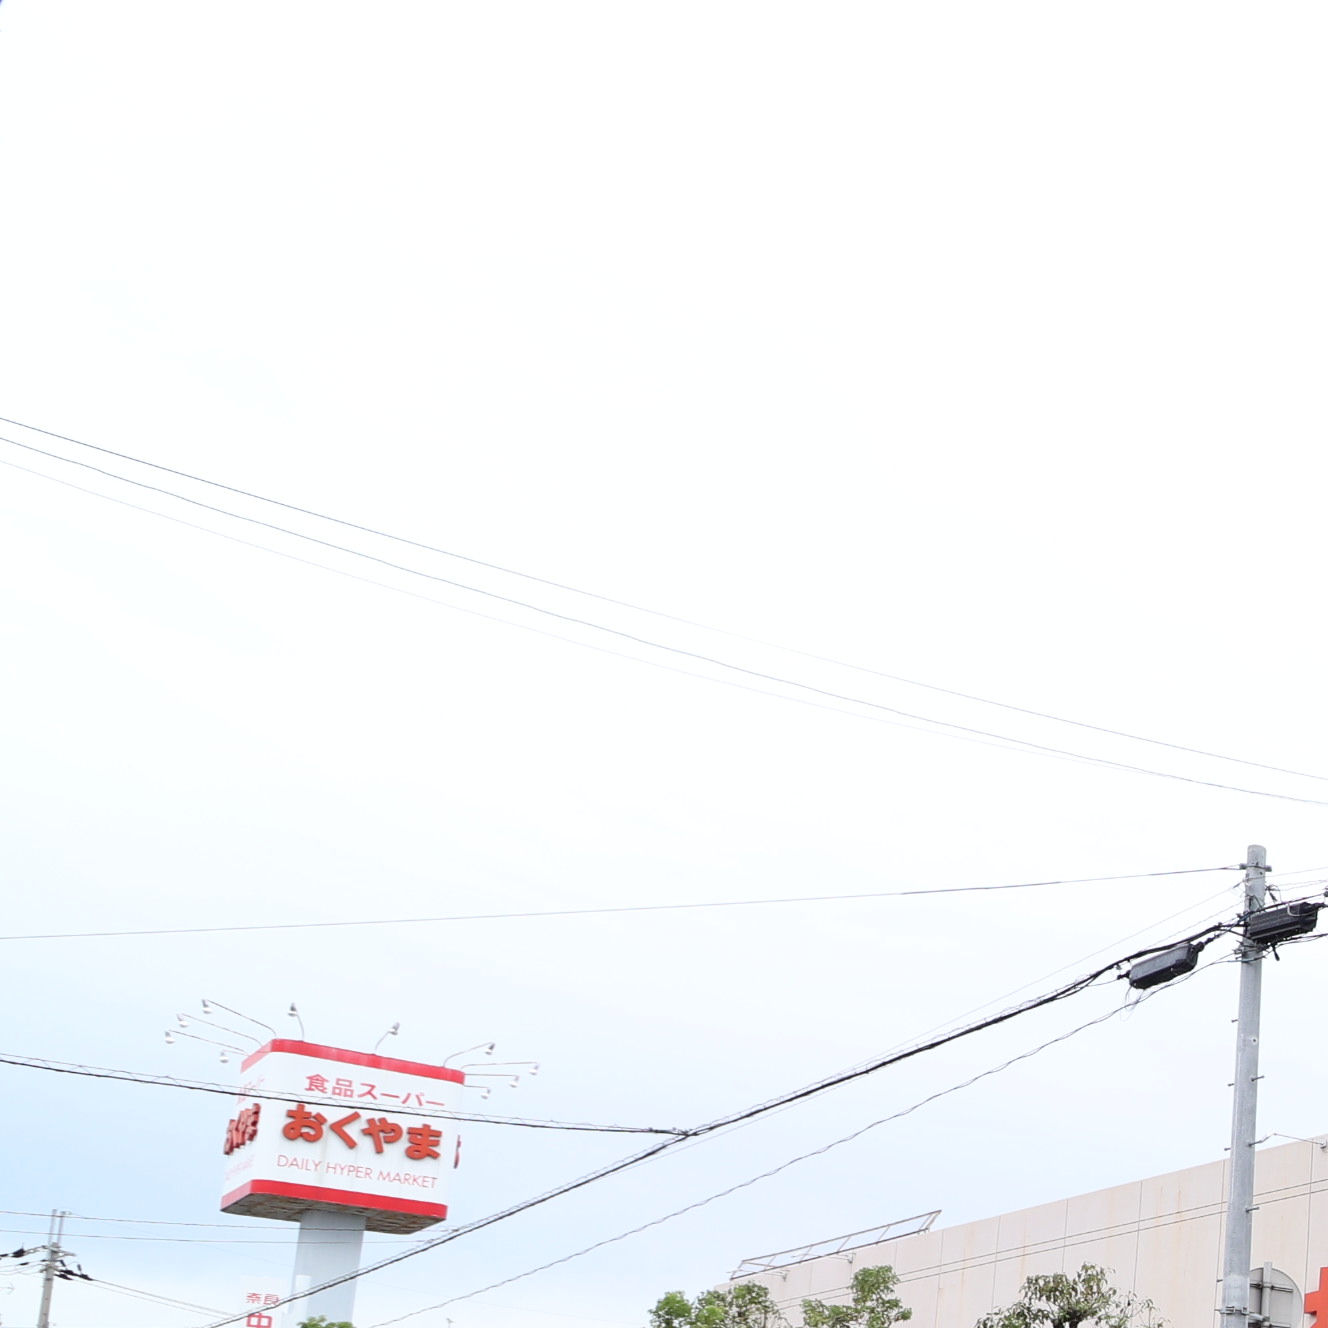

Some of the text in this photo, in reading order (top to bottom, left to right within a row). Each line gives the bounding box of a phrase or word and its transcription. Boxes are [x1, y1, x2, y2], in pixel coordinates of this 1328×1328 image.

[304, 1073, 445, 1107] 食品スーパー
[282, 1103, 443, 1161] おくやま
[276, 1154, 322, 1172] DAILY
[325, 1161, 373, 1180] HYPER
[377, 1171, 439, 1189] MARKET
